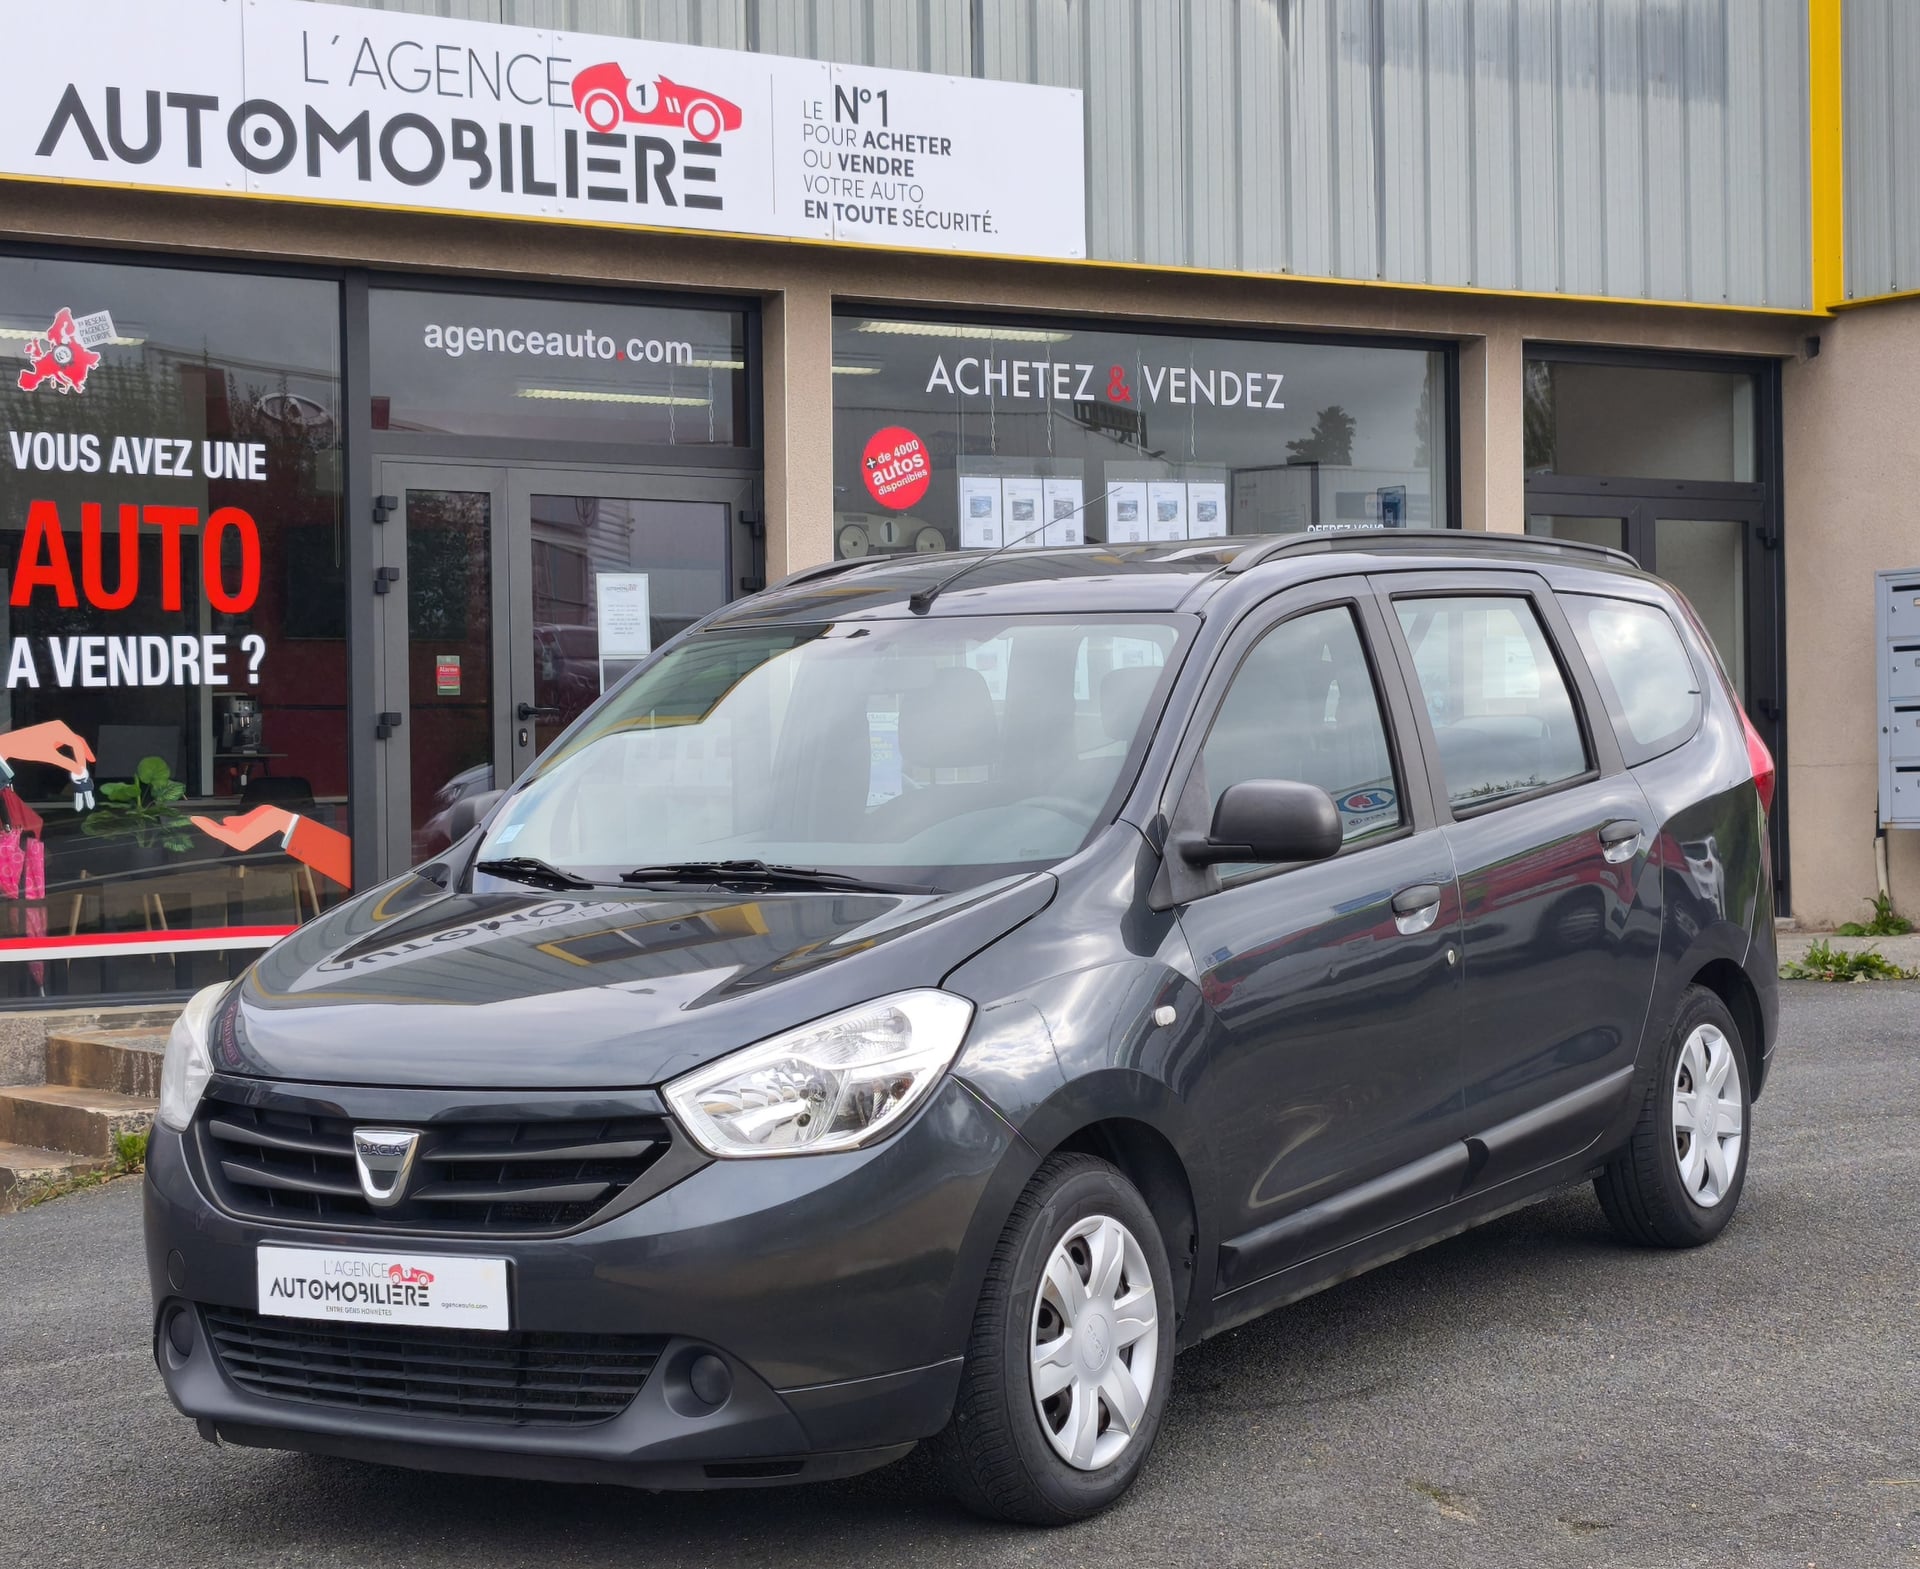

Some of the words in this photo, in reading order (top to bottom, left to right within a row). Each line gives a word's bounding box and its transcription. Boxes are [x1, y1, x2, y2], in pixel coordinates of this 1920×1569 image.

[303, 30, 576, 109] L'AGENCE
[635, 83, 647, 107] 1
[803, 100, 823, 121] LE
[34, 82, 724, 211] AUTOMOBILIERE
[803, 123, 858, 148] POUR
[862, 130, 952, 157] ACHETER
[803, 148, 832, 170] OU
[837, 152, 915, 178] VENDRE
[803, 173, 866, 199] VOTRE
[870, 180, 925, 204] AUTO
[804, 199, 829, 220] EN
[832, 202, 899, 227] TOUTE
[902, 204, 1000, 235] SÉCURITÉ.
[424, 322, 693, 365] agenceauto.com
[925, 354, 1096, 401] ACHETEZ
[1106, 364, 1132, 404] &
[1142, 365, 1286, 410] VENDEZ
[9, 430, 101, 473] VOUS
[109, 436, 193, 478] AVEZ
[203, 440, 267, 480] UNE
[878, 453, 891, 465] de
[894, 440, 919, 458] 4000
[873, 453, 924, 486] autos
[878, 469, 928, 495] disponibles
[885, 521, 893, 542] 1
[9, 499, 262, 614] AUTO
[6, 636, 40, 689] A
[47, 635, 230, 689] VENDRE
[240, 633, 267, 685] ?
[359, 1143, 404, 1156] DACIA
[323, 1259, 389, 1279] L'AGENCE
[269, 1276, 430, 1307] AUTOMOBILIERE
[441, 1301, 489, 1310] agenceauto.com
[325, 1305, 344, 1313] ENTRE
[344, 1306, 360, 1314] GENS
